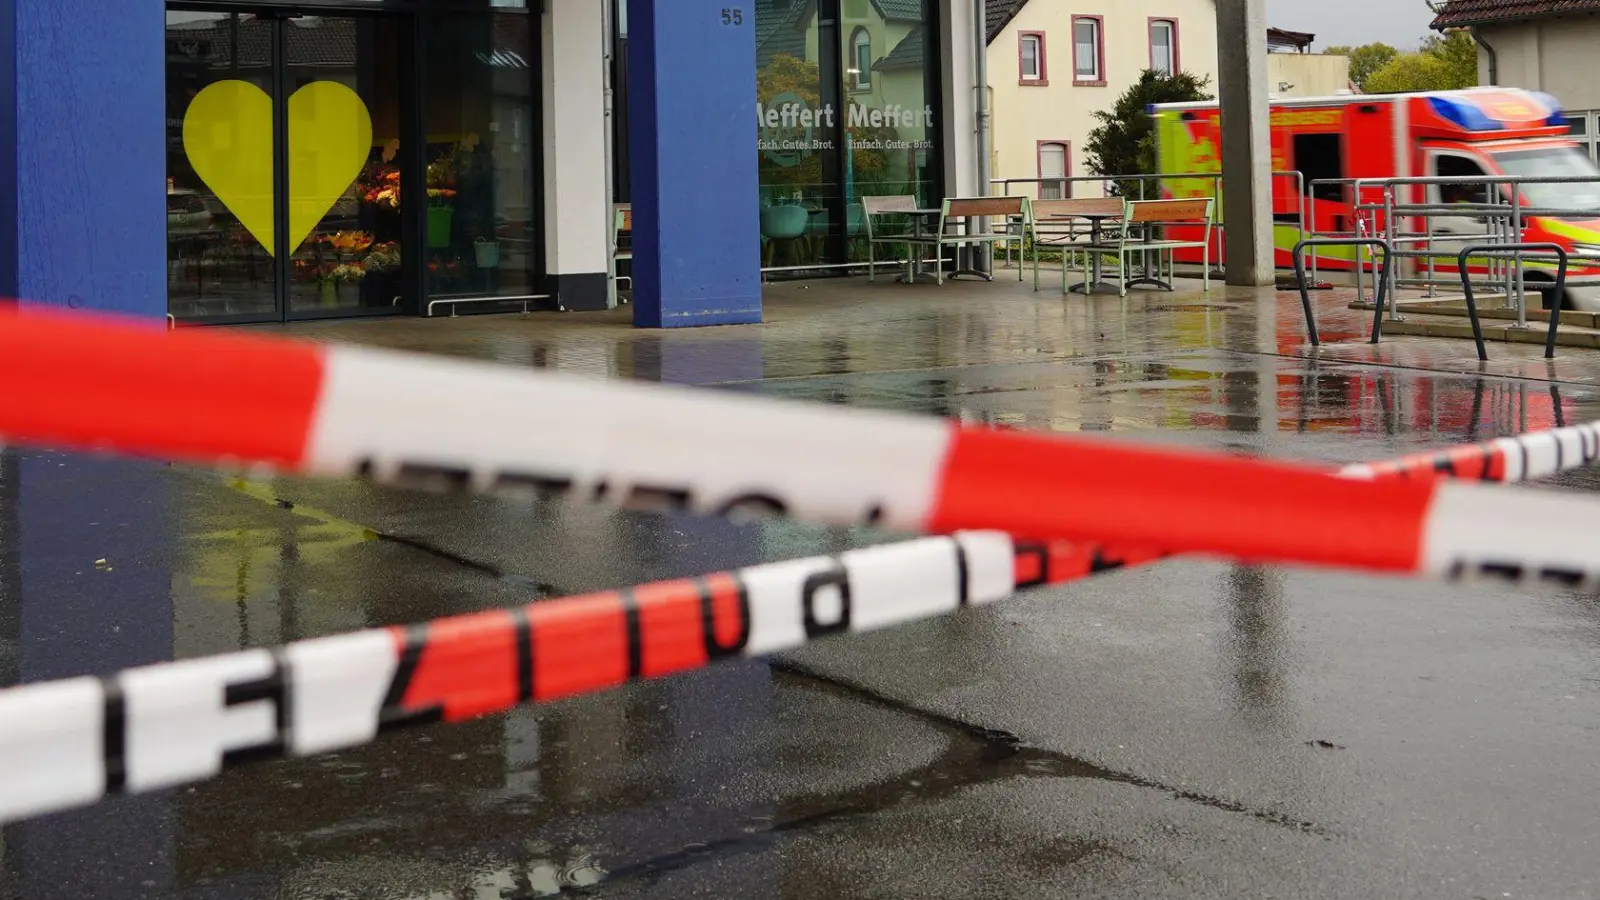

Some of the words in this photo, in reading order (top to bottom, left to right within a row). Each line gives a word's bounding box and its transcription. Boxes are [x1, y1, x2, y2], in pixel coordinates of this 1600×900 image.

[721, 8, 742, 26] 55
[848, 103, 933, 128] Meffert
[757, 139, 780, 150] fach.
[782, 140, 812, 150] Gutes.
[812, 139, 835, 150] Brot.
[849, 139, 884, 150] Einfach.
[885, 140, 912, 150] Gutes.
[913, 139, 934, 149] Brot.
